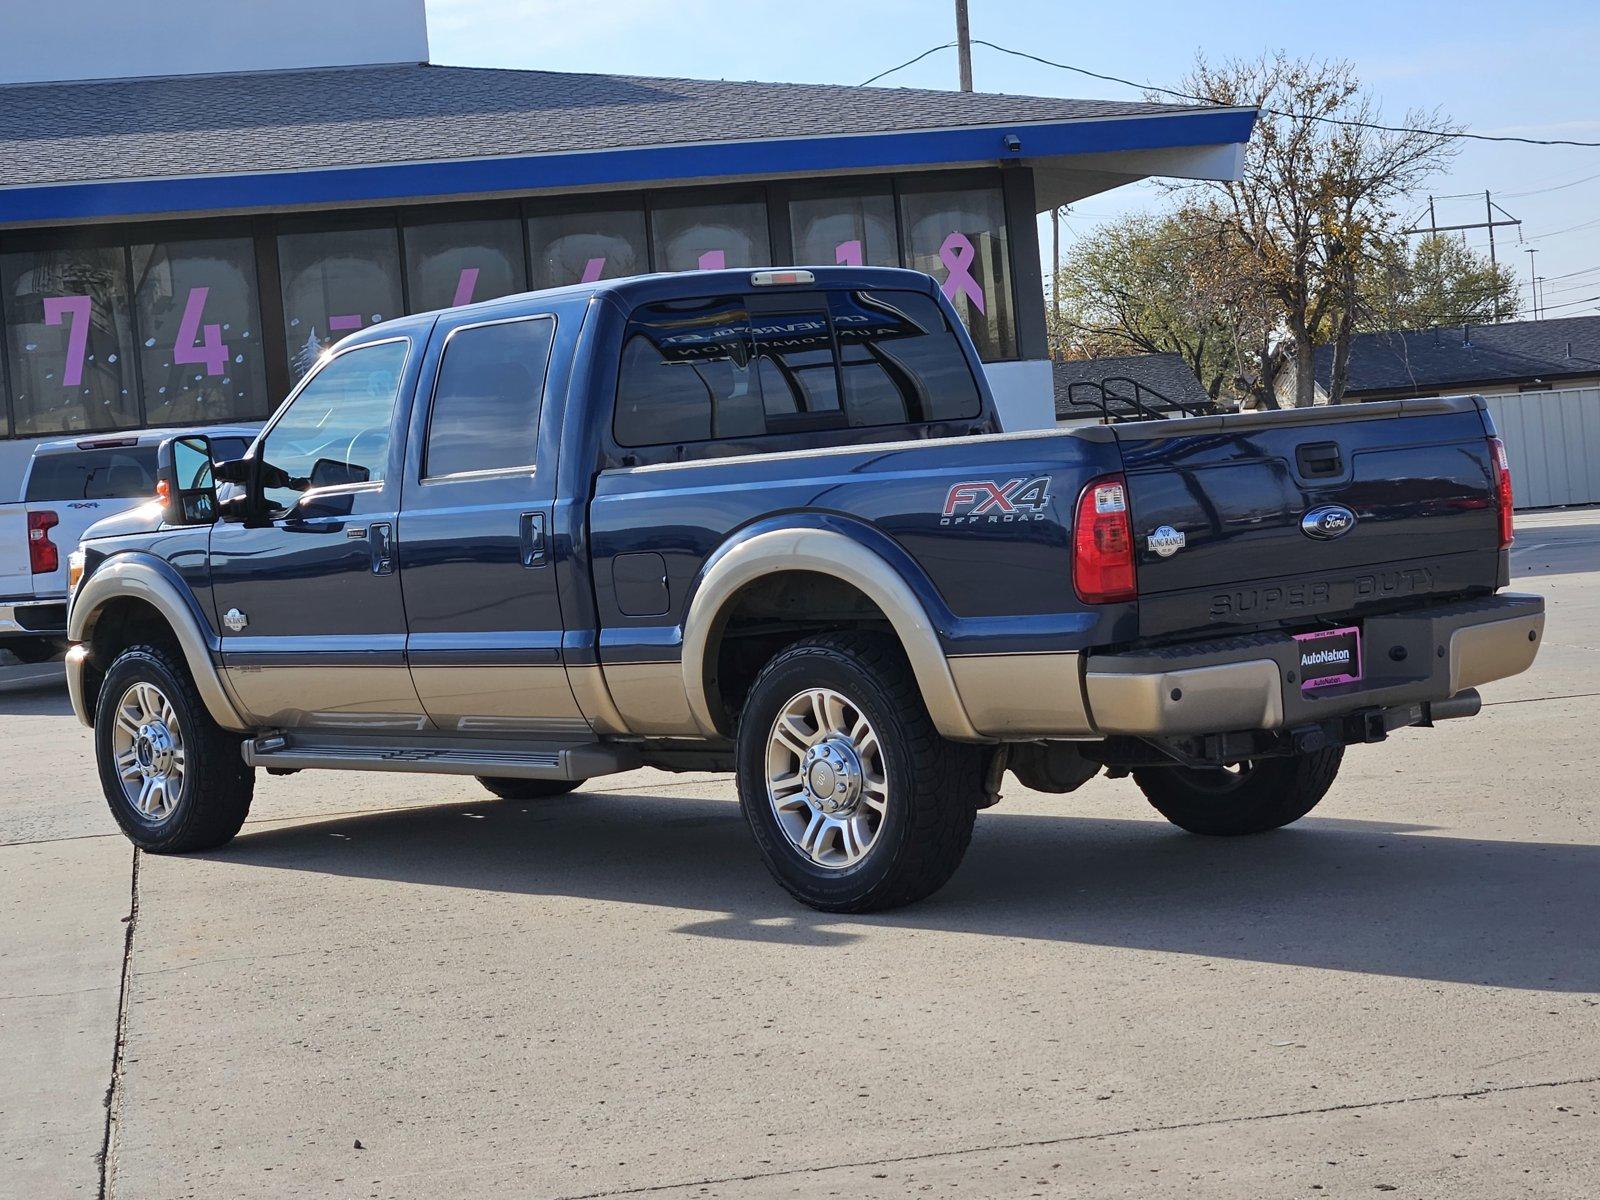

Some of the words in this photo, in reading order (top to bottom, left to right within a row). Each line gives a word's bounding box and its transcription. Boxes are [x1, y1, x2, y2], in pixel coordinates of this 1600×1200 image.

[941, 476, 1052, 517] FX4
[940, 516, 979, 525] OFF
[988, 513, 1045, 522] ROAD
[1324, 513, 1347, 529] Ford
[1150, 538, 1164, 547] KING
[1165, 534, 1184, 545] RANCH
[1209, 582, 1330, 620] SUPER
[1353, 565, 1441, 596] DUTY
[1301, 649, 1350, 666] AutoNation
